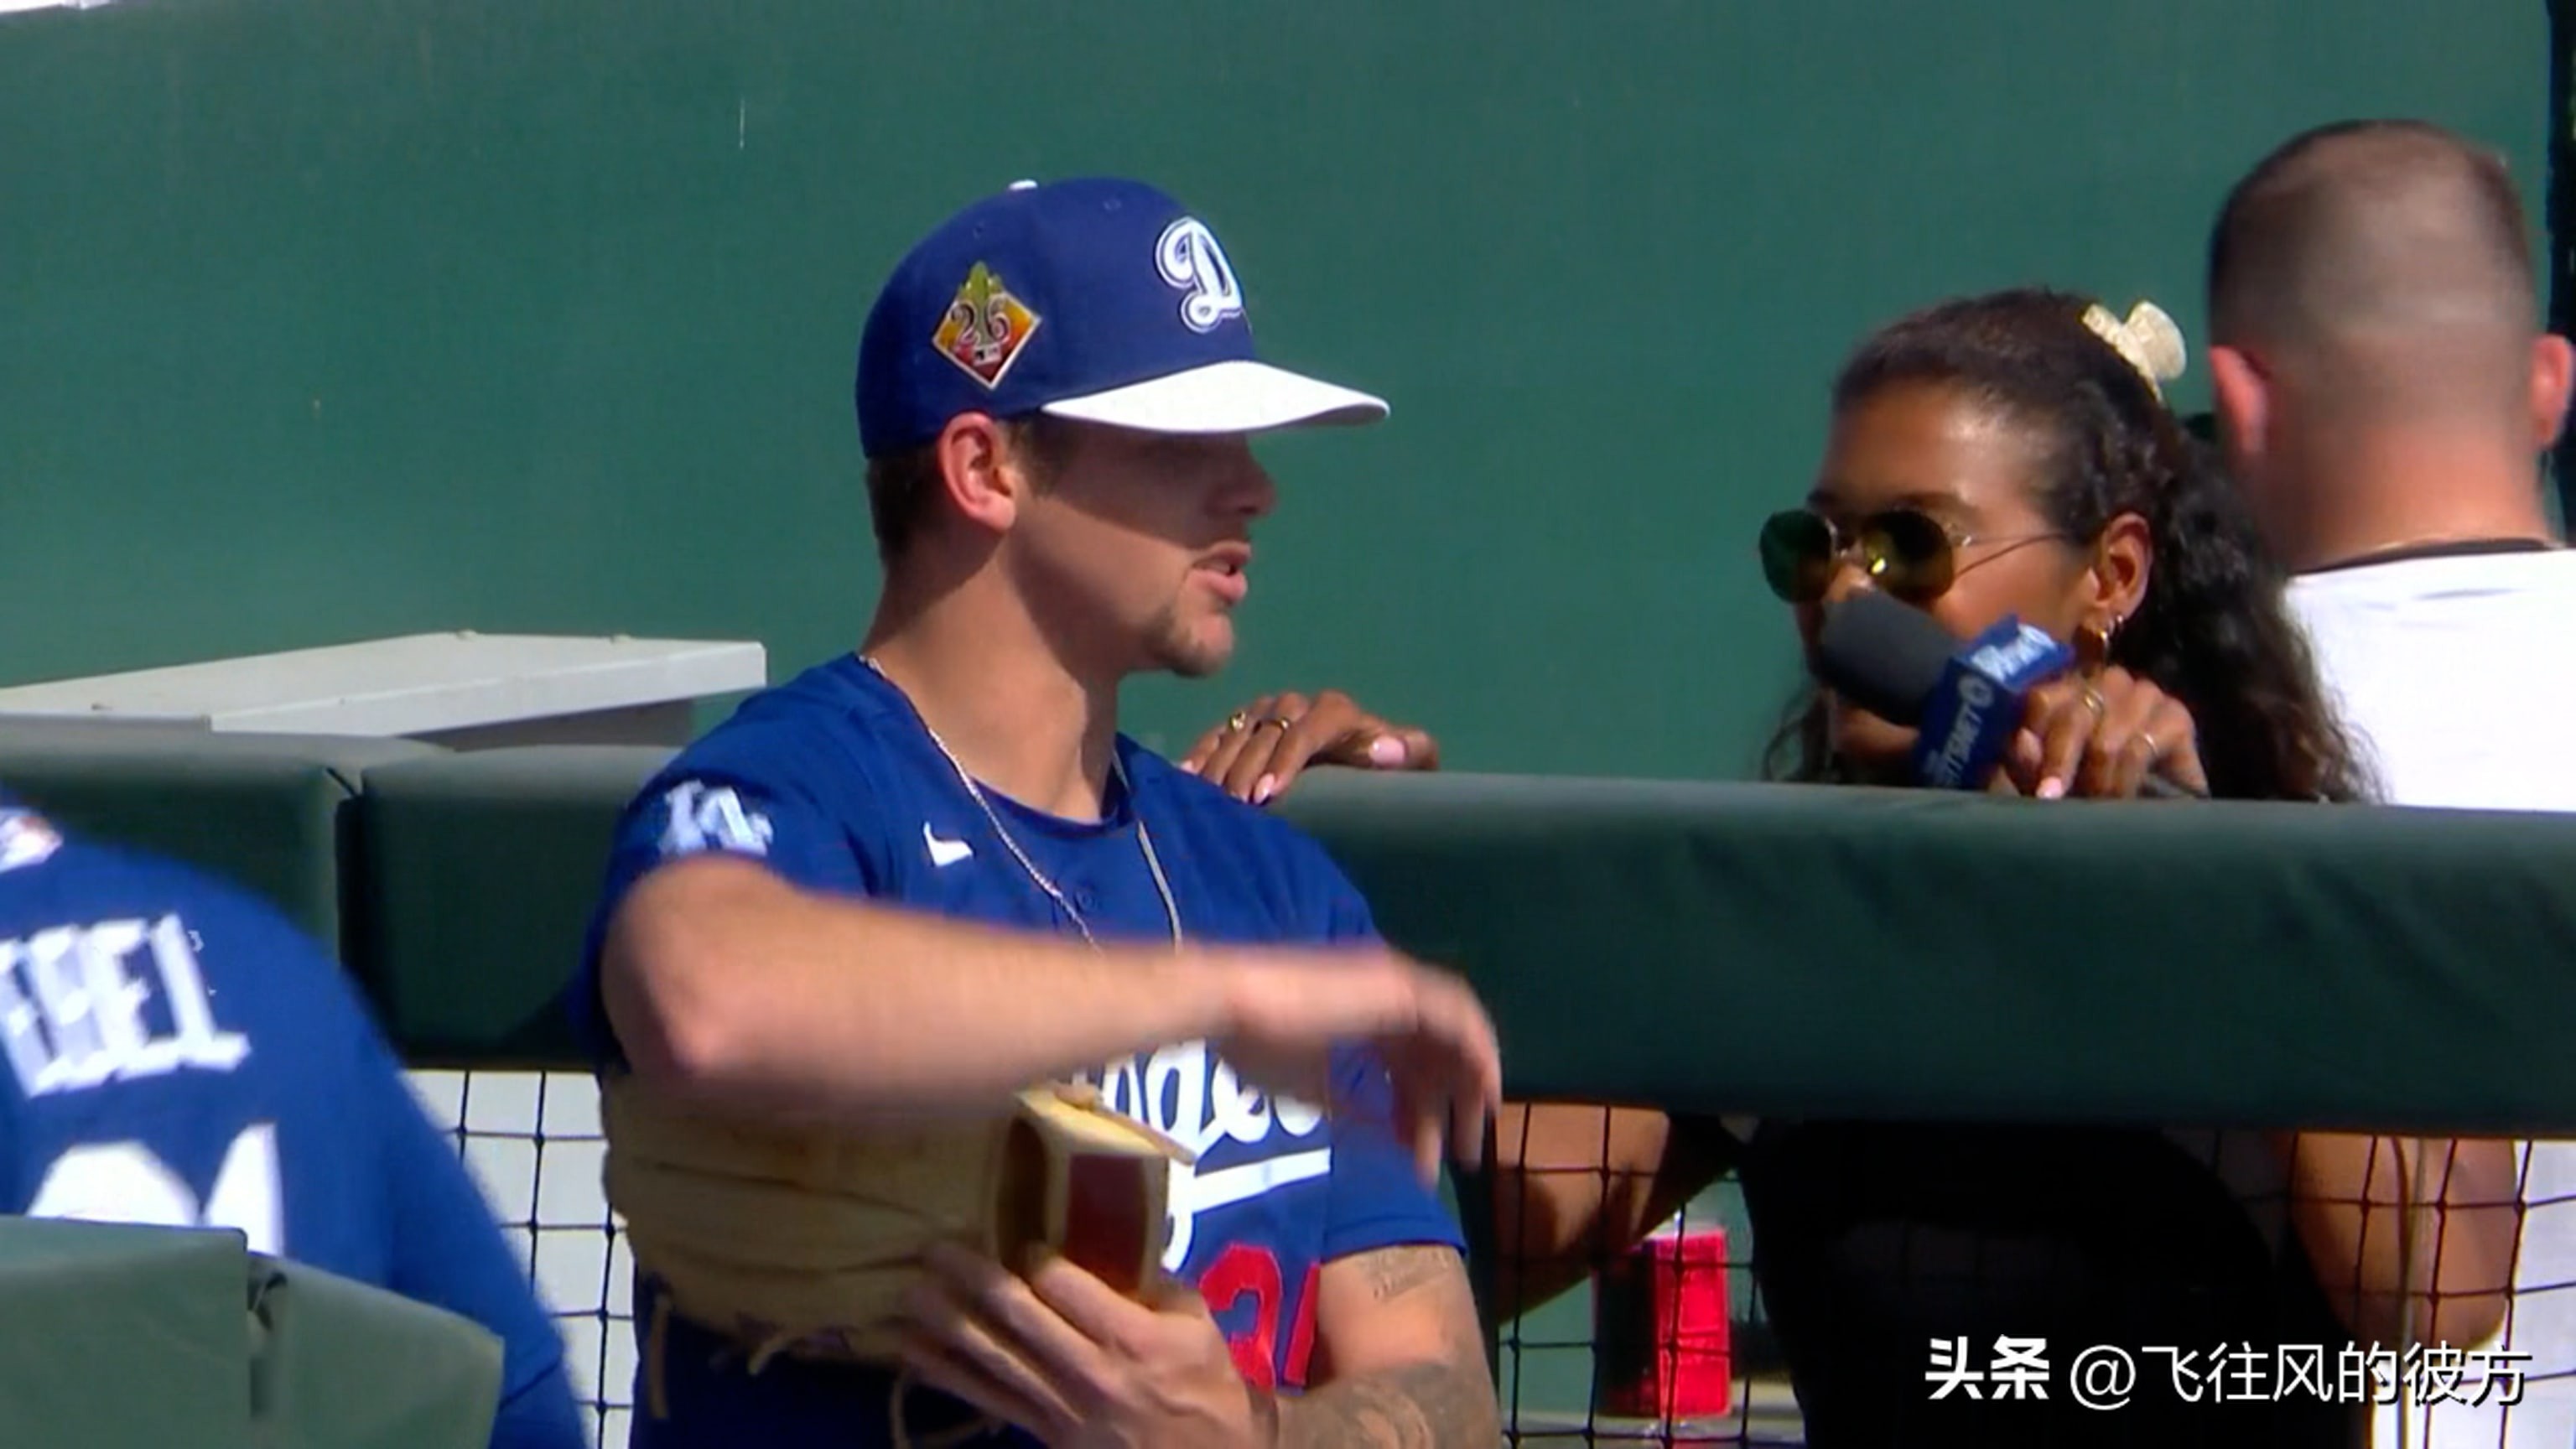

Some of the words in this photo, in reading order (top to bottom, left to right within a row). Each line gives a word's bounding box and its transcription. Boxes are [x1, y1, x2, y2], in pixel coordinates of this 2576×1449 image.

[950, 293, 1011, 352] 26
[1156, 216, 1243, 334] D
[659, 780, 773, 857] LA
[1199, 1242, 1320, 1394] 3
